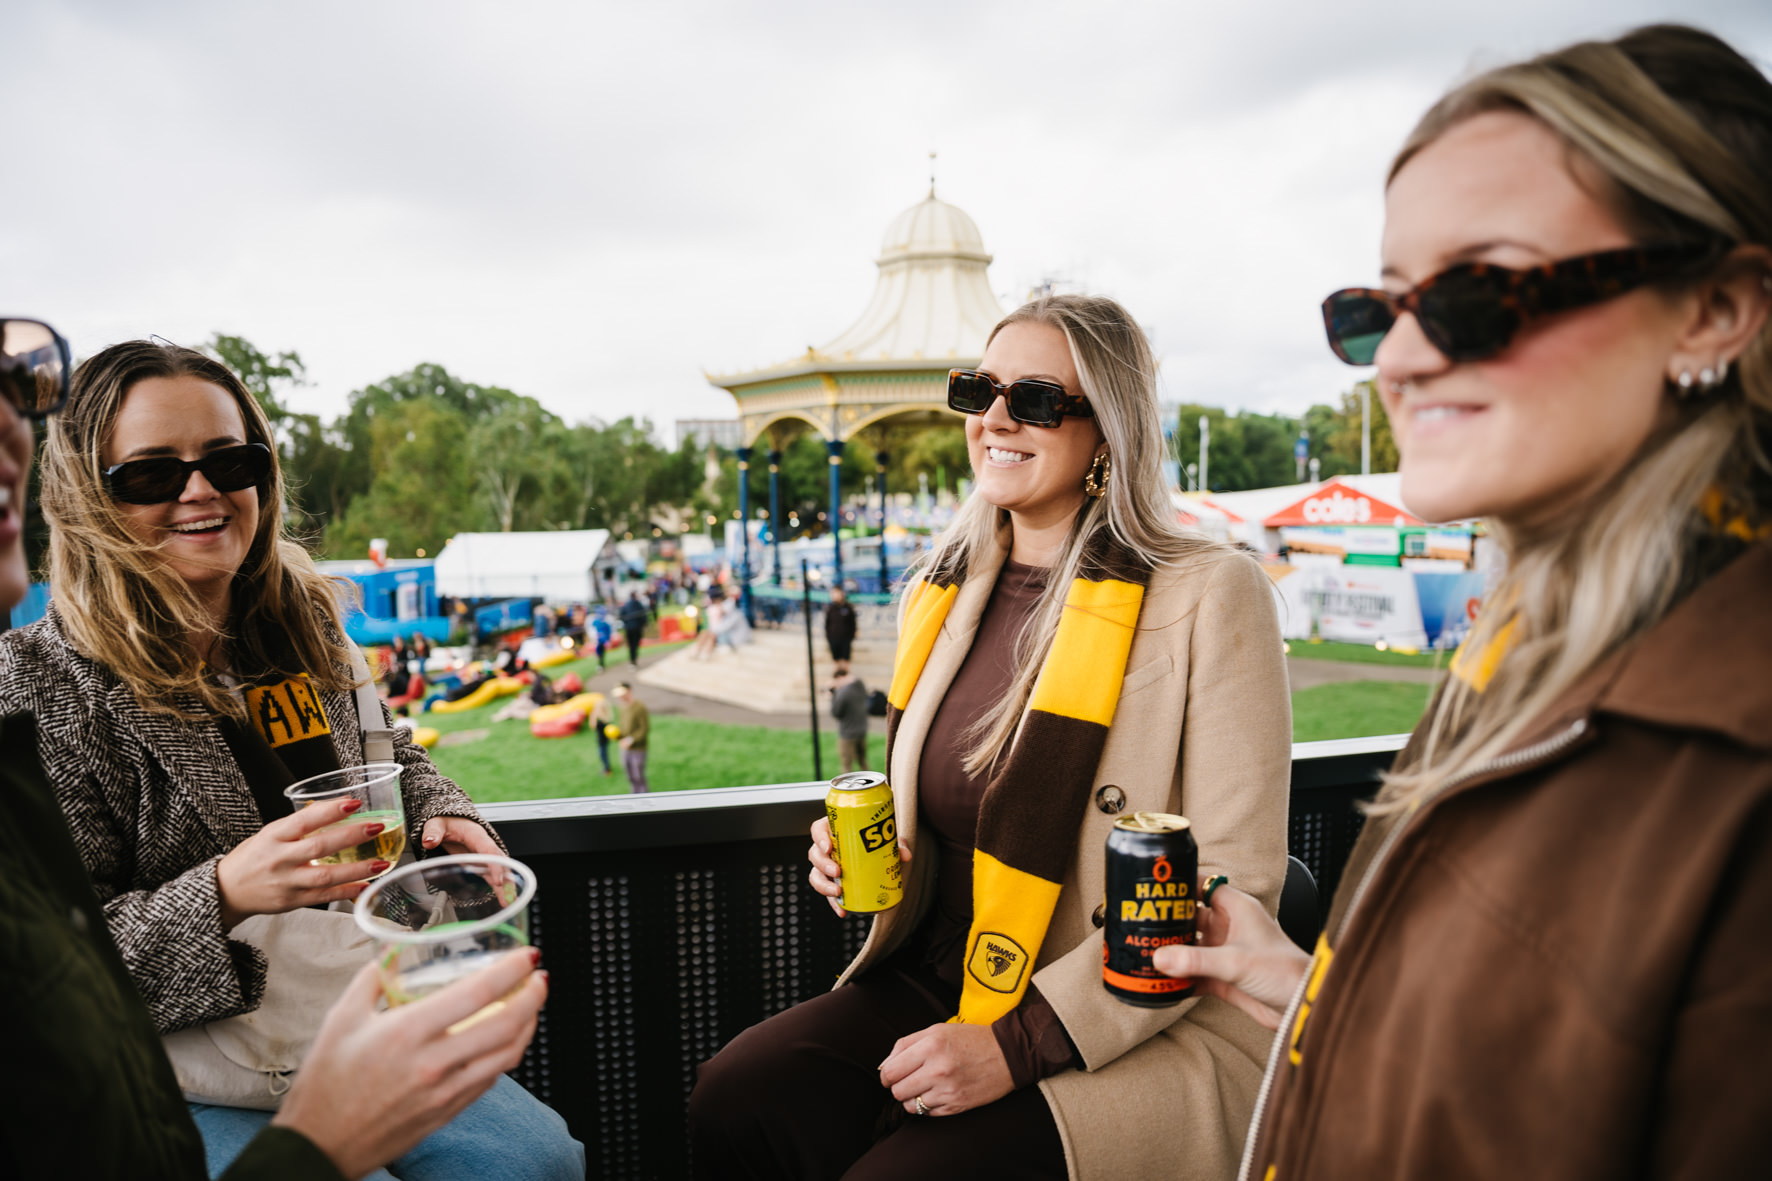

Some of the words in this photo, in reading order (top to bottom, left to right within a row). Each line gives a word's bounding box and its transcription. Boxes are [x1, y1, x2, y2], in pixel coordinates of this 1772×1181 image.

[1303, 490, 1371, 523] coles
[1135, 882, 1189, 899] HARD
[1121, 899, 1196, 922] RATED
[1125, 932, 1193, 948] ALCOHOLIC
[986, 941, 1017, 962] HAWKS
